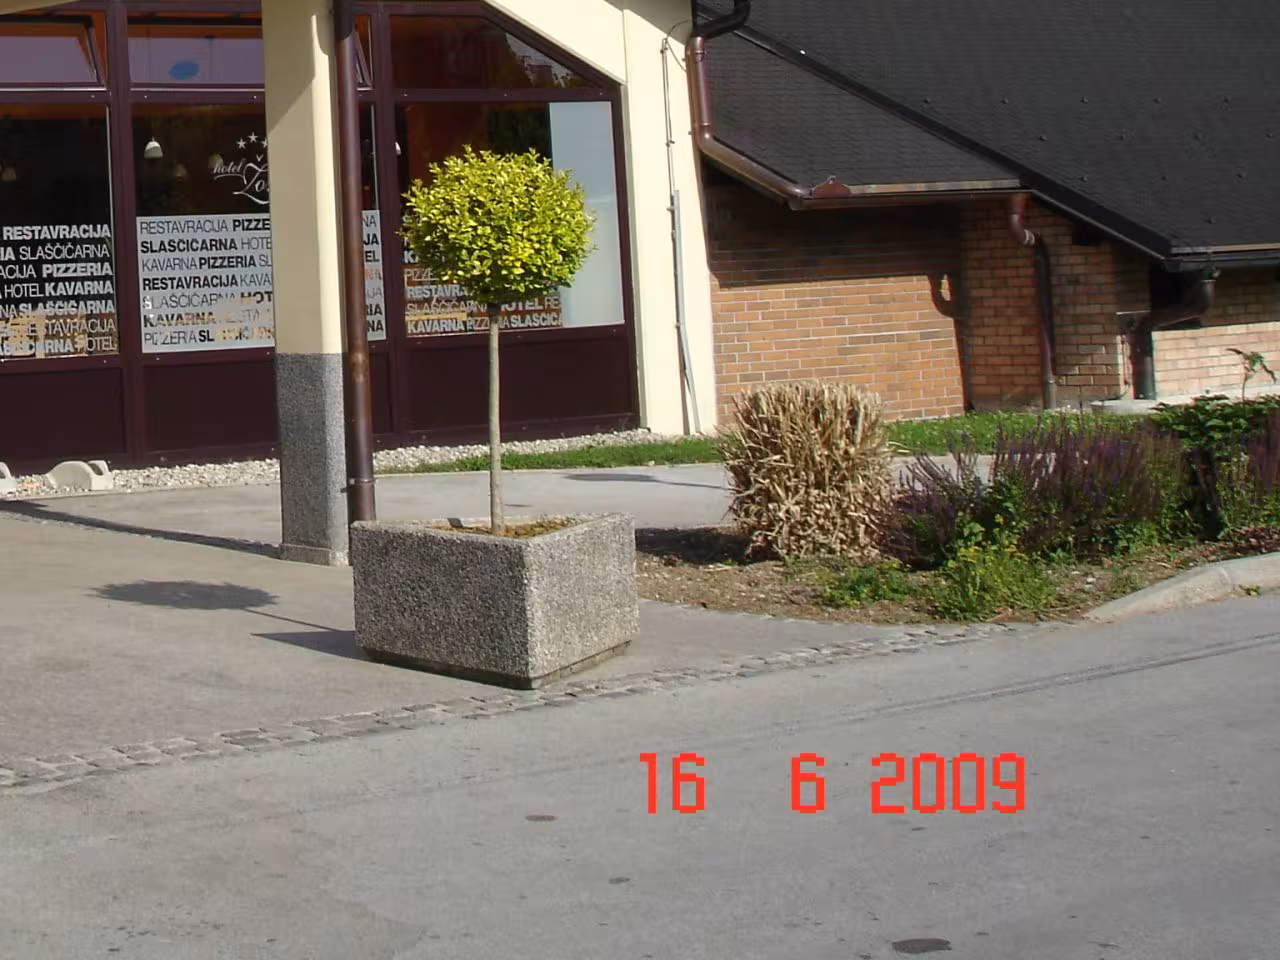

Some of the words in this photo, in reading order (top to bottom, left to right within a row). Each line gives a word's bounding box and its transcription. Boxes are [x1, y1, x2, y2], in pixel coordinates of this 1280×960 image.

[233, 153, 270, 205] Žo
[3, 224, 111, 240] RESTAVRACIJA
[140, 219, 228, 235] RESTAVRACIJA
[19, 243, 110, 260] SLAŠČIČARNA
[42, 262, 113, 278] PIZZERIA
[142, 257, 198, 273] KAVARNA
[199, 255, 257, 269] PIZZERIA
[4, 283, 44, 299] HOTEL
[45, 281, 113, 296] KAVARNA
[143, 274, 238, 291] RESTAVRACIJA
[143, 311, 216, 328] KAVARNA
[407, 318, 465, 334] KAVARNA
